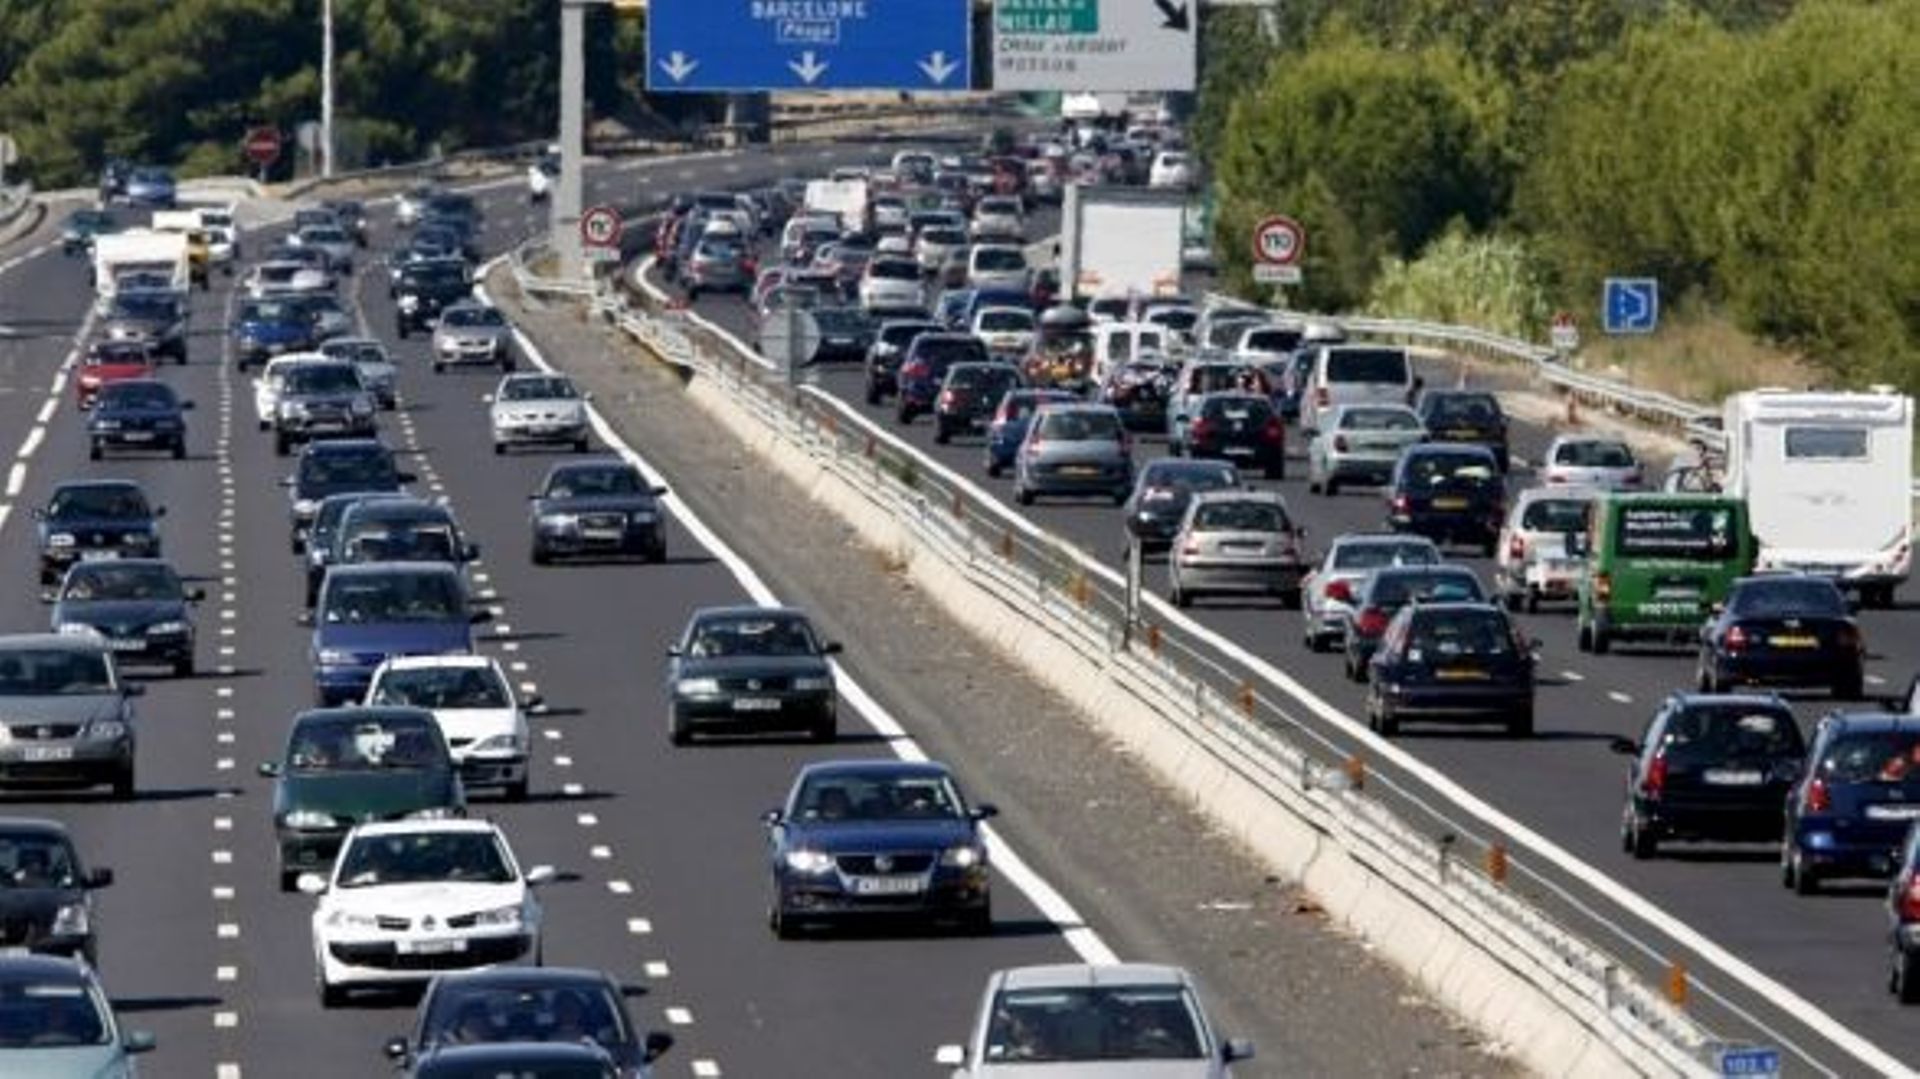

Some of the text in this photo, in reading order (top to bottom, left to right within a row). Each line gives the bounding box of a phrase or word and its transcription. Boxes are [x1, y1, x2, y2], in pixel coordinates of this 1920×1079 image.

[752, 0, 868, 19] BARCELONE
[998, 13, 1073, 31] MILLAU
[1264, 233, 1292, 250] 110
